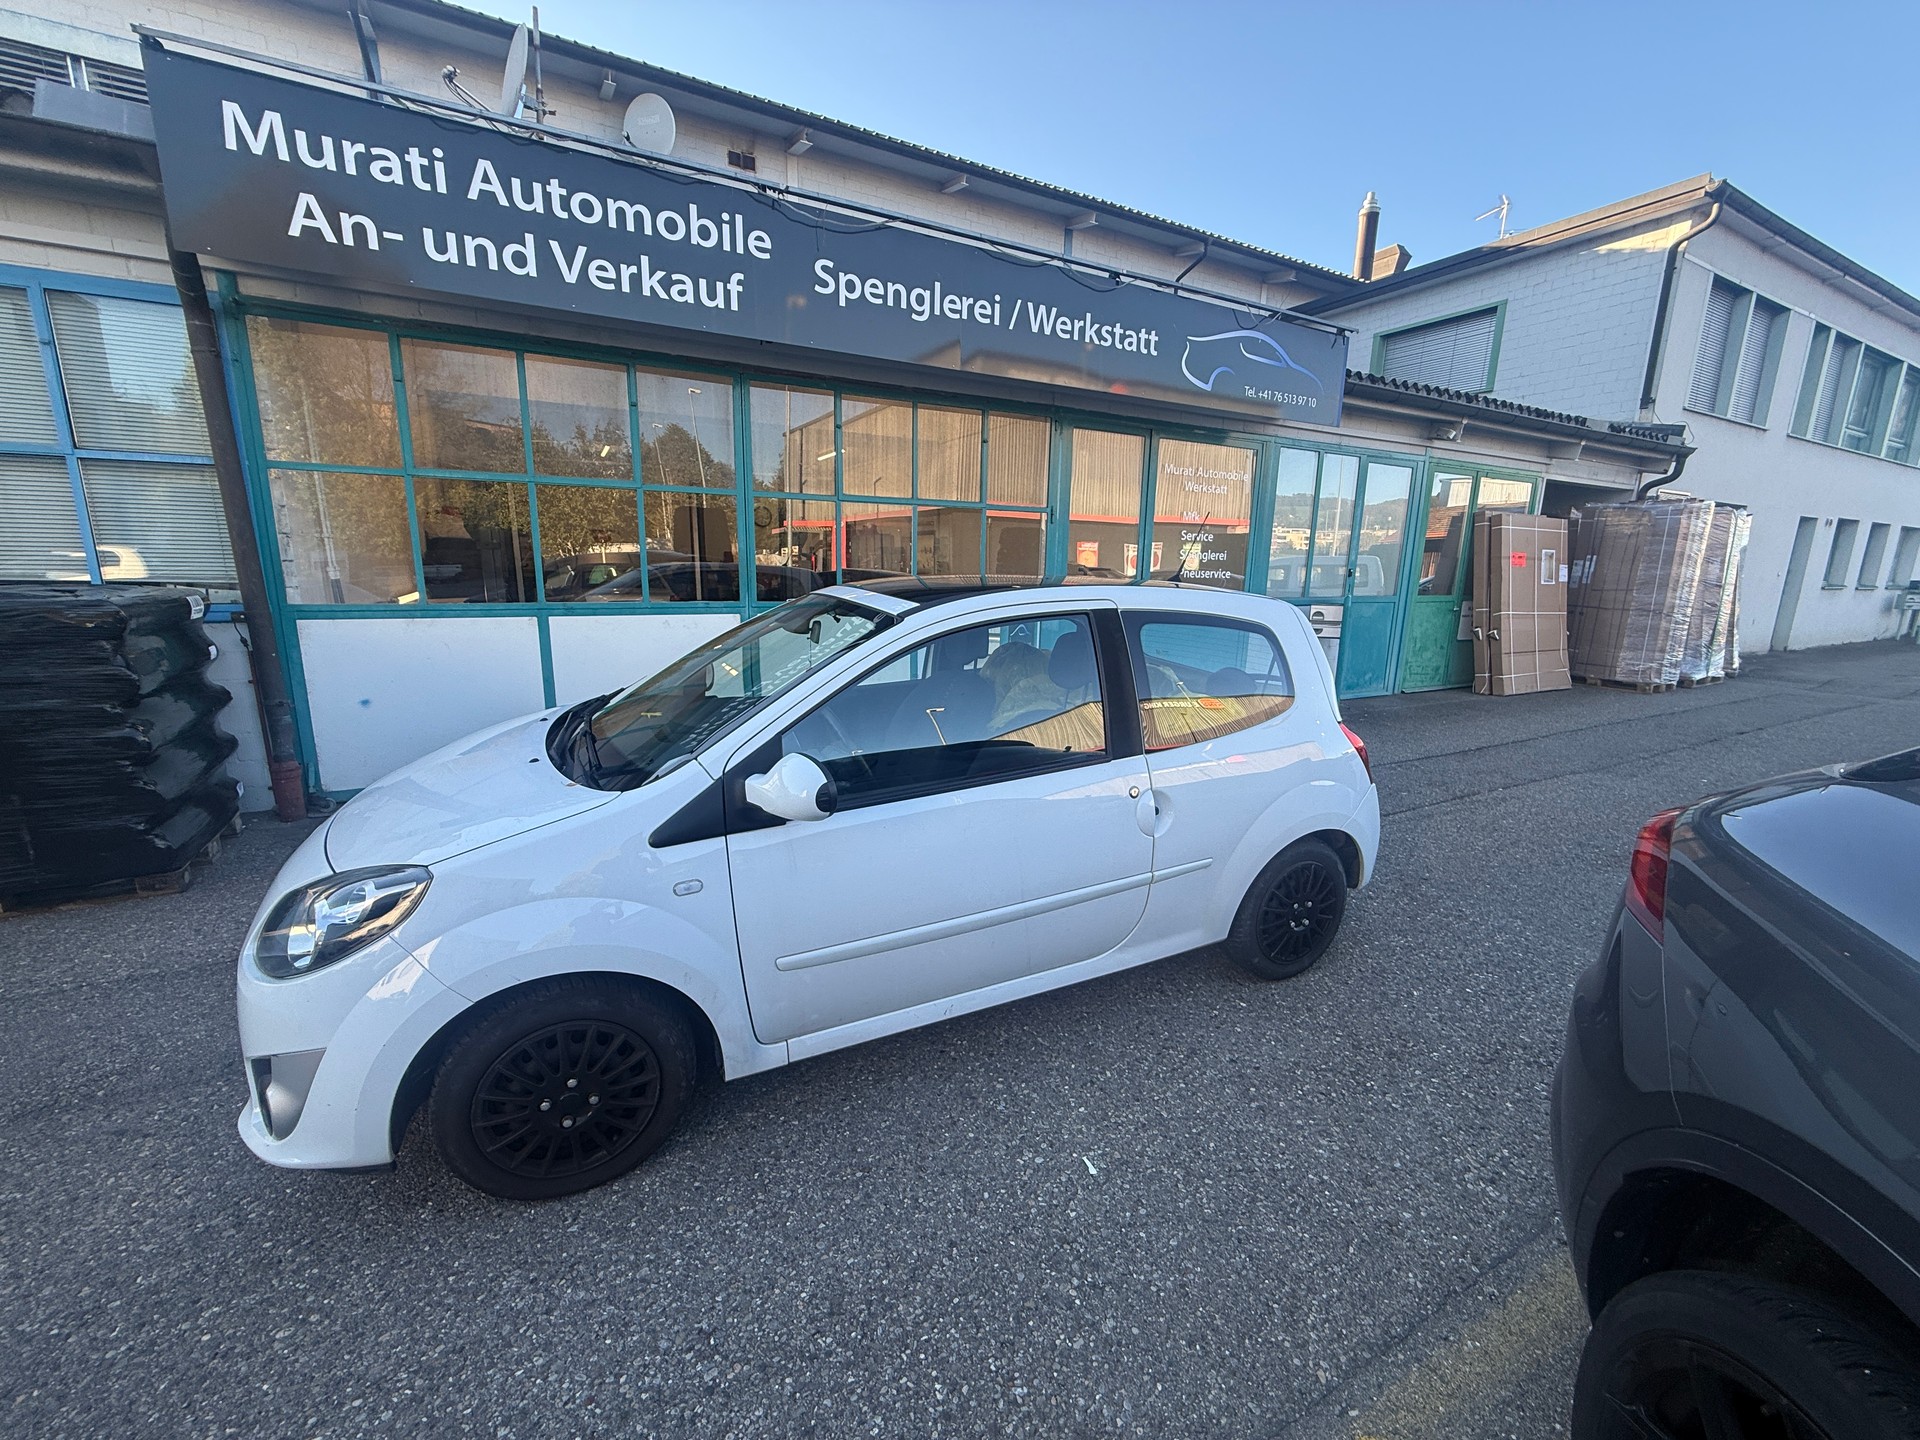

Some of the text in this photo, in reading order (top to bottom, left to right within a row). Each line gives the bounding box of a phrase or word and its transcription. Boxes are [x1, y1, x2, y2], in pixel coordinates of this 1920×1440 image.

[221, 99, 773, 260] Murati Automobile
[287, 191, 744, 312] An- und Verkauf
[812, 258, 1159, 357] Spenglerei / Werkstatt
[1244, 385, 1317, 408] Tel. +41 76 513 97 10
[1164, 463, 1249, 482] Murati Automobile
[1185, 481, 1228, 495] Werkstatt
[1181, 530, 1214, 542] Service
[1180, 549, 1228, 563] Snglerei
